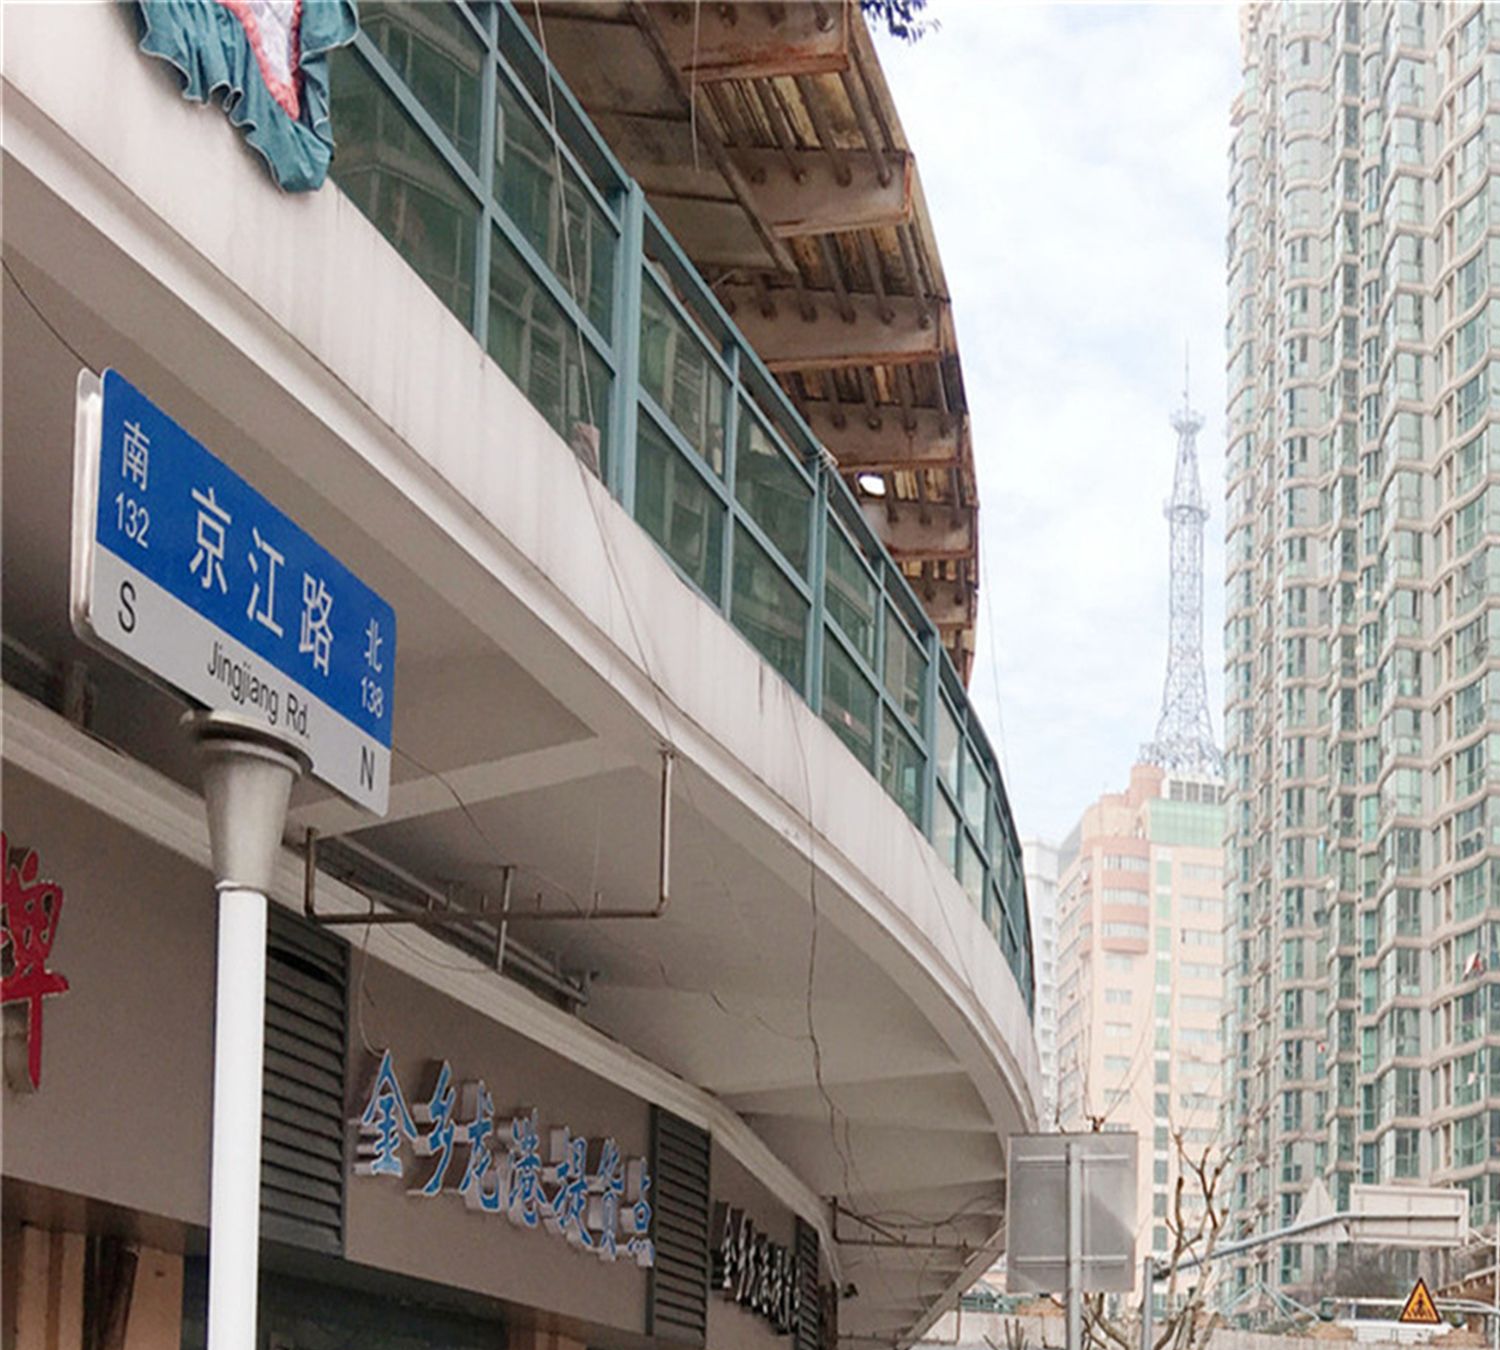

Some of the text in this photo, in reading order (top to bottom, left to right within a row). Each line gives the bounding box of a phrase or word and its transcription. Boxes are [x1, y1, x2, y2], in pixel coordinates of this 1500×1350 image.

[121, 420, 151, 492] 南
[115, 493, 150, 549] 132
[117, 580, 137, 634] S
[189, 486, 335, 678] 京江路
[364, 618, 383, 674] 北
[206, 641, 311, 739] Jingjiang Rd.
[359, 676, 384, 719] 138
[360, 745, 375, 792] N
